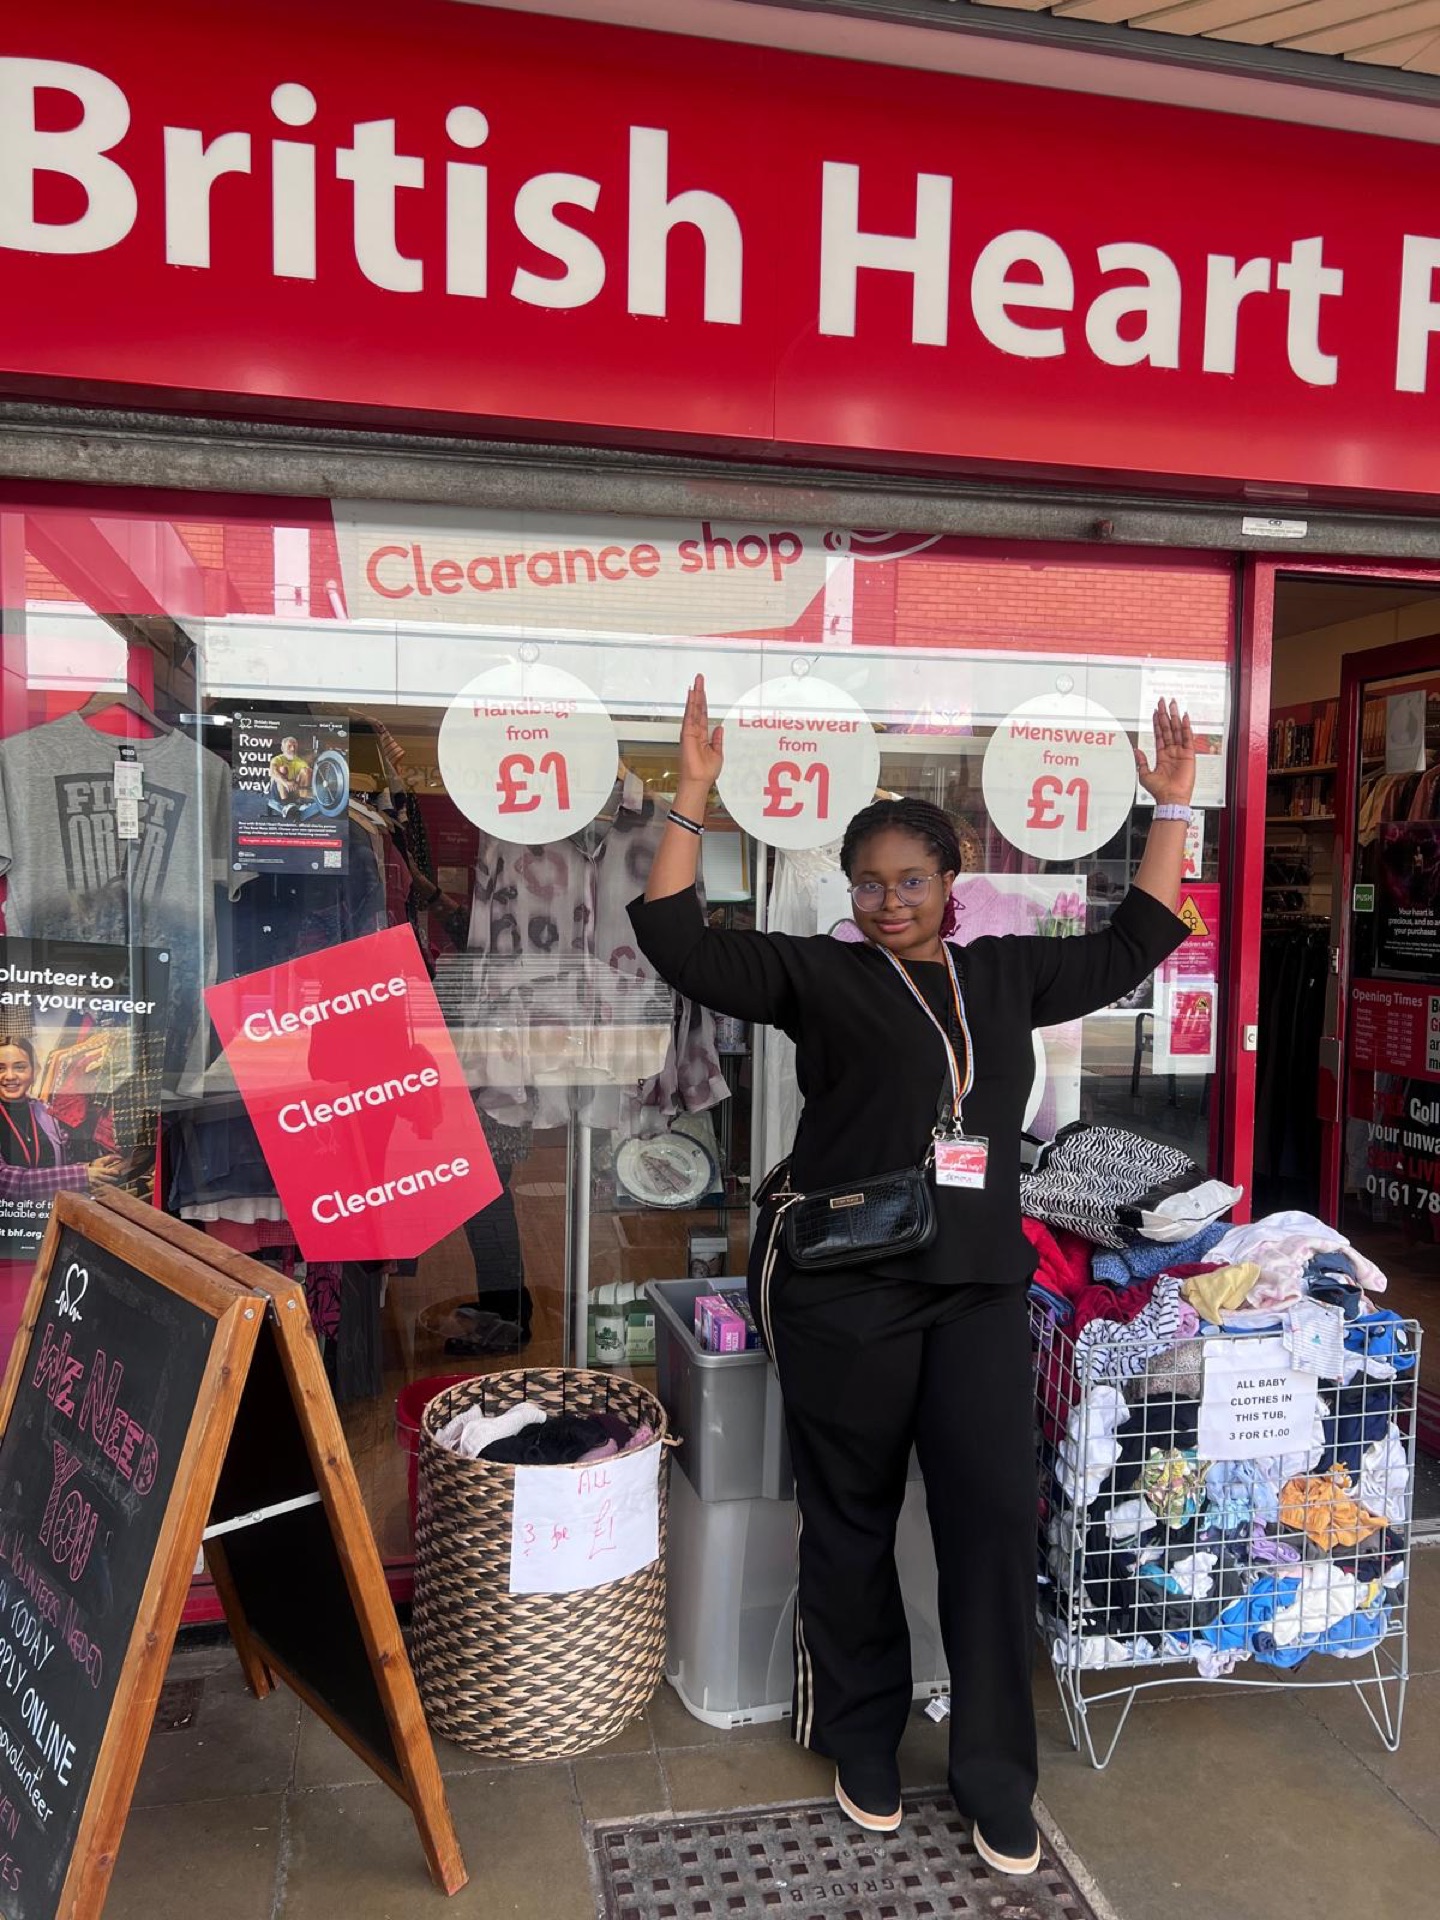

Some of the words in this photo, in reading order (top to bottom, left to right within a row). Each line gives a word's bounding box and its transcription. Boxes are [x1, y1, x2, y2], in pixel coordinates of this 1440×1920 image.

[0, 56, 743, 325] British
[818, 160, 1343, 386] Heart
[366, 542, 661, 599] Clearance
[678, 522, 804, 582] shop
[473, 697, 578, 718] Handbags
[738, 708, 861, 733] Ladieswear
[239, 733, 273, 748] Row
[506, 725, 549, 740] from
[1010, 720, 1117, 746] Menswear
[779, 737, 817, 752] from
[239, 751, 273, 764] your
[1043, 750, 1079, 767] from
[239, 766, 271, 777] own
[239, 780, 270, 794] way
[496, 752, 570, 814] £1
[763, 761, 829, 819] £1
[1026, 775, 1089, 832] £1
[90, 972, 114, 989] to
[36, 993, 86, 1013] your
[89, 999, 156, 1014] career
[1352, 988, 1392, 1006] Opening
[1393, 992, 1423, 1008] Times
[244, 977, 407, 1042] Clearance
[278, 1067, 439, 1133] Clearance
[1409, 1097, 1439, 1124] Coll
[1367, 1122, 1400, 1143] your
[312, 1157, 470, 1223] Clearance
[1366, 1174, 1410, 1206] 0161
[1416, 1187, 1440, 1214] 78
[17, 1200, 33, 1212] gift
[36, 1200, 46, 1209] of
[1236, 1380, 1255, 1389] ALL
[1258, 1378, 1287, 1388] BABY
[33, 1323, 84, 1418] WE
[79, 1349, 159, 1495] NEED
[1230, 1395, 1279, 1406] CLOTHES
[1282, 1394, 1292, 1402] IN
[1235, 1411, 1259, 1422] THIS
[1229, 1432, 1236, 1440] 3
[1239, 1431, 1260, 1440] FOR
[1263, 1428, 1290, 1438] £1.00
[38, 1440, 98, 1581] YOU
[523, 1523, 536, 1544] 3
[11, 1599, 55, 1671] TODAY
[22, 1688, 76, 1786] ONLINE
[790, 1889, 804, 1902] B
[812, 1878, 895, 1899] GRADE
